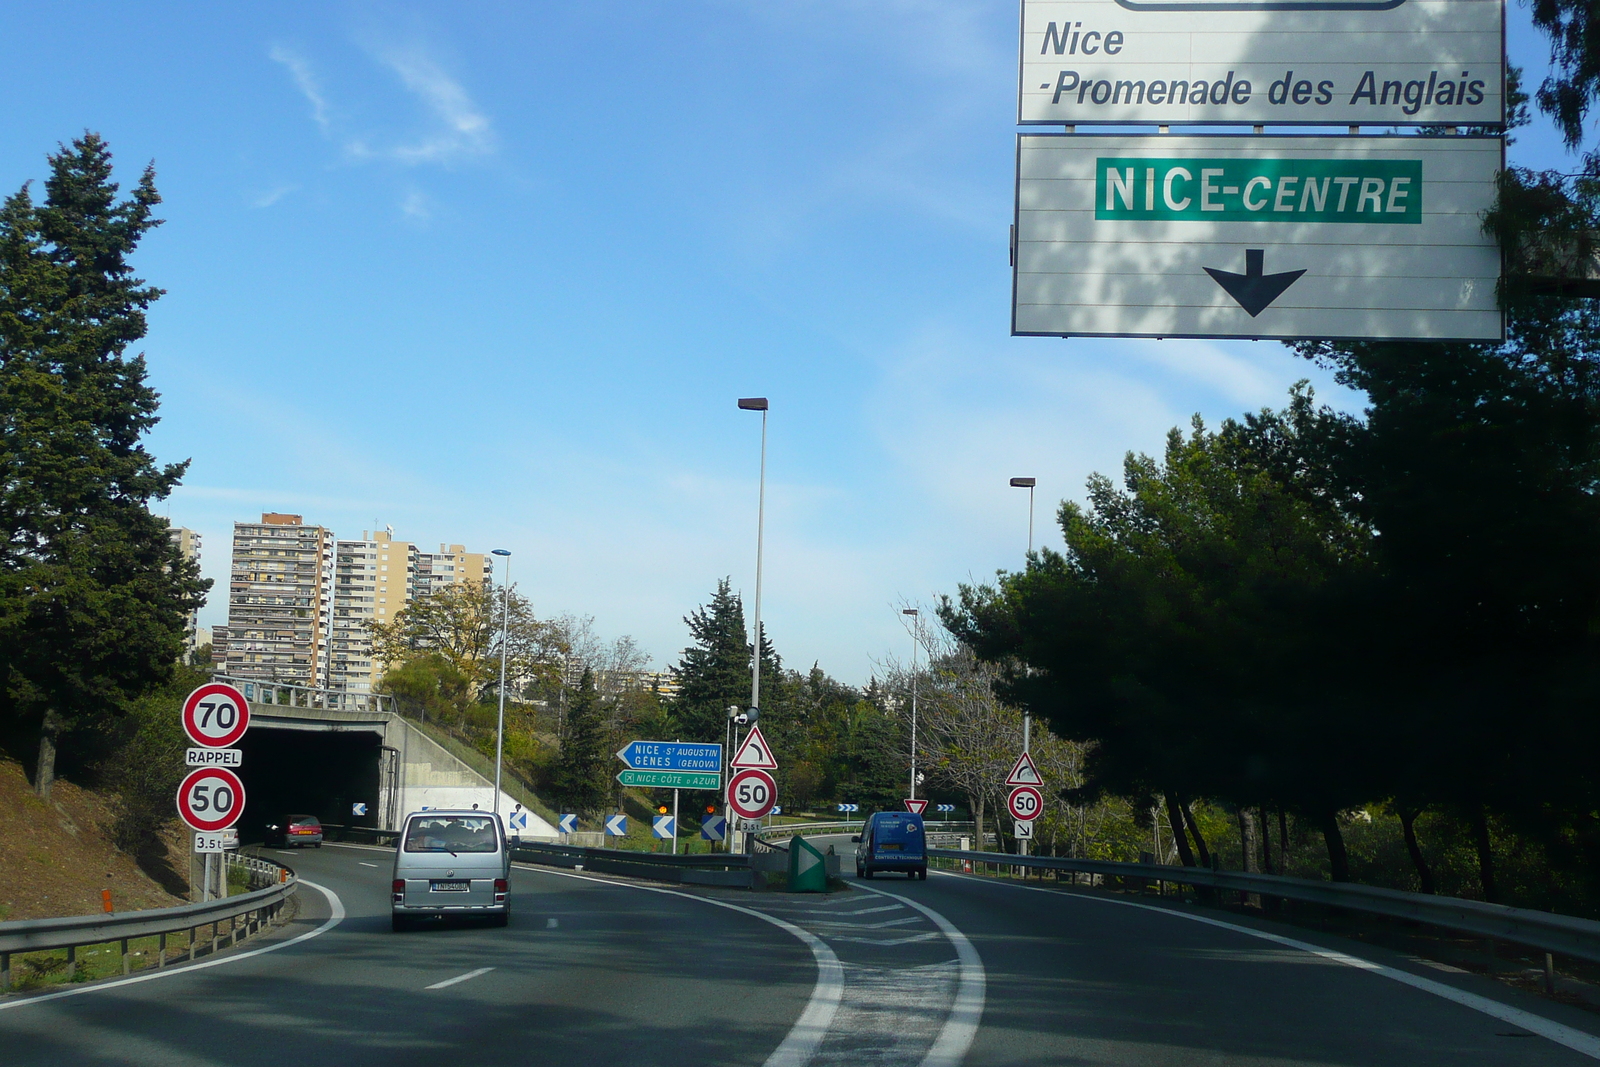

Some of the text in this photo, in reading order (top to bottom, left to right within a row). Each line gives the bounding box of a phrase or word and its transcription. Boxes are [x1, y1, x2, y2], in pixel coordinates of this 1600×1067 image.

[1040, 21, 1124, 55] Nice
[1268, 70, 1334, 106] des
[1349, 70, 1485, 116] Anglais
[1105, 166, 1411, 213] NICE-CENTRE
[199, 702, 236, 729] 70
[188, 751, 239, 764] RAPPEL
[635, 744, 659, 755] NICE
[677, 747, 718, 757] AUGUSTIN
[678, 759, 718, 769] (GENOVA)
[191, 785, 233, 813] 50
[738, 784, 767, 804] 50
[1015, 796, 1036, 811] 50
